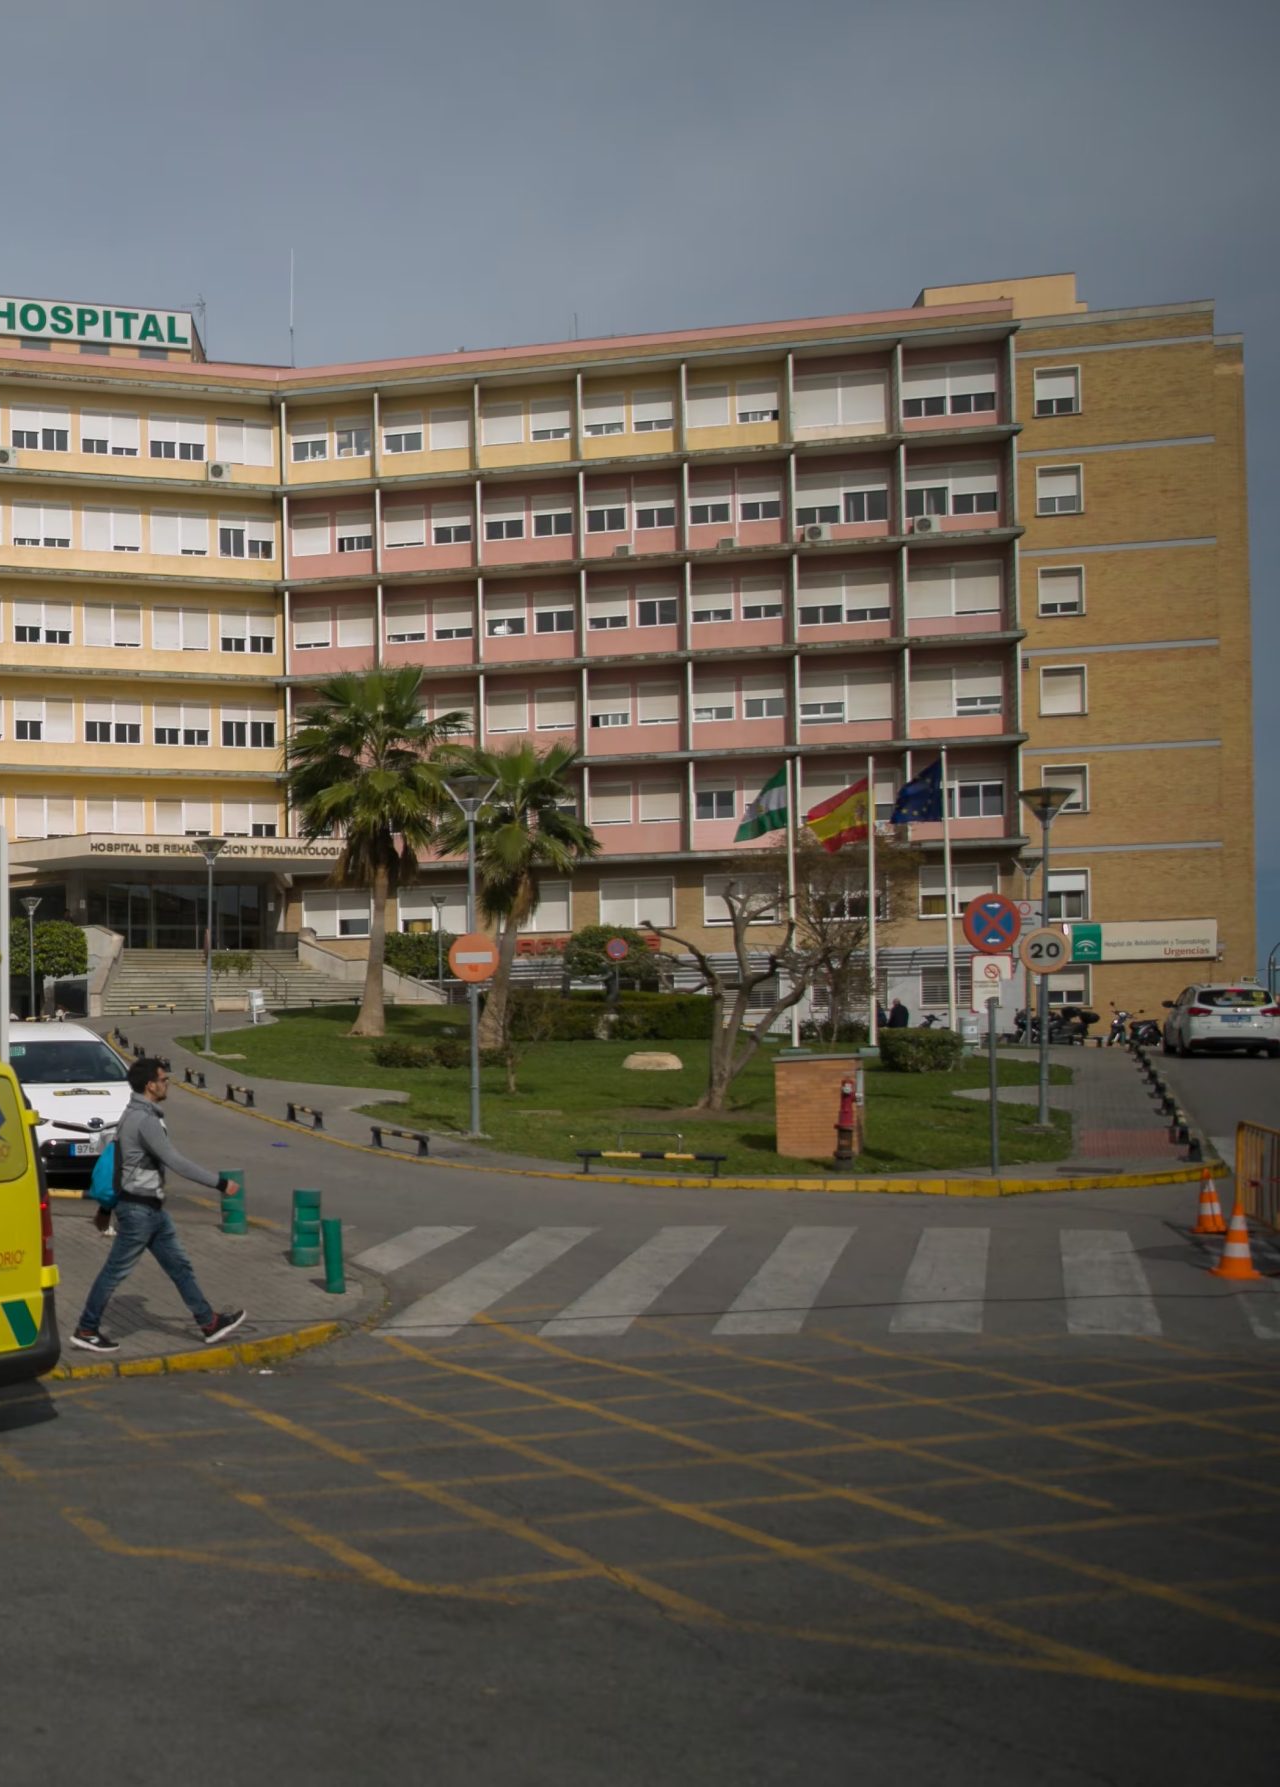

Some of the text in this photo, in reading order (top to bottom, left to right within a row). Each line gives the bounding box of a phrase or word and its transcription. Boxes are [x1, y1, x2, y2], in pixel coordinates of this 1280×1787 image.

[90, 842, 142, 853] HOSPITAL
[145, 843, 160, 854] DE
[251, 845, 259, 855] Y
[1030, 942, 1060, 958] 20
[1163, 946, 1210, 957] Urgencias
